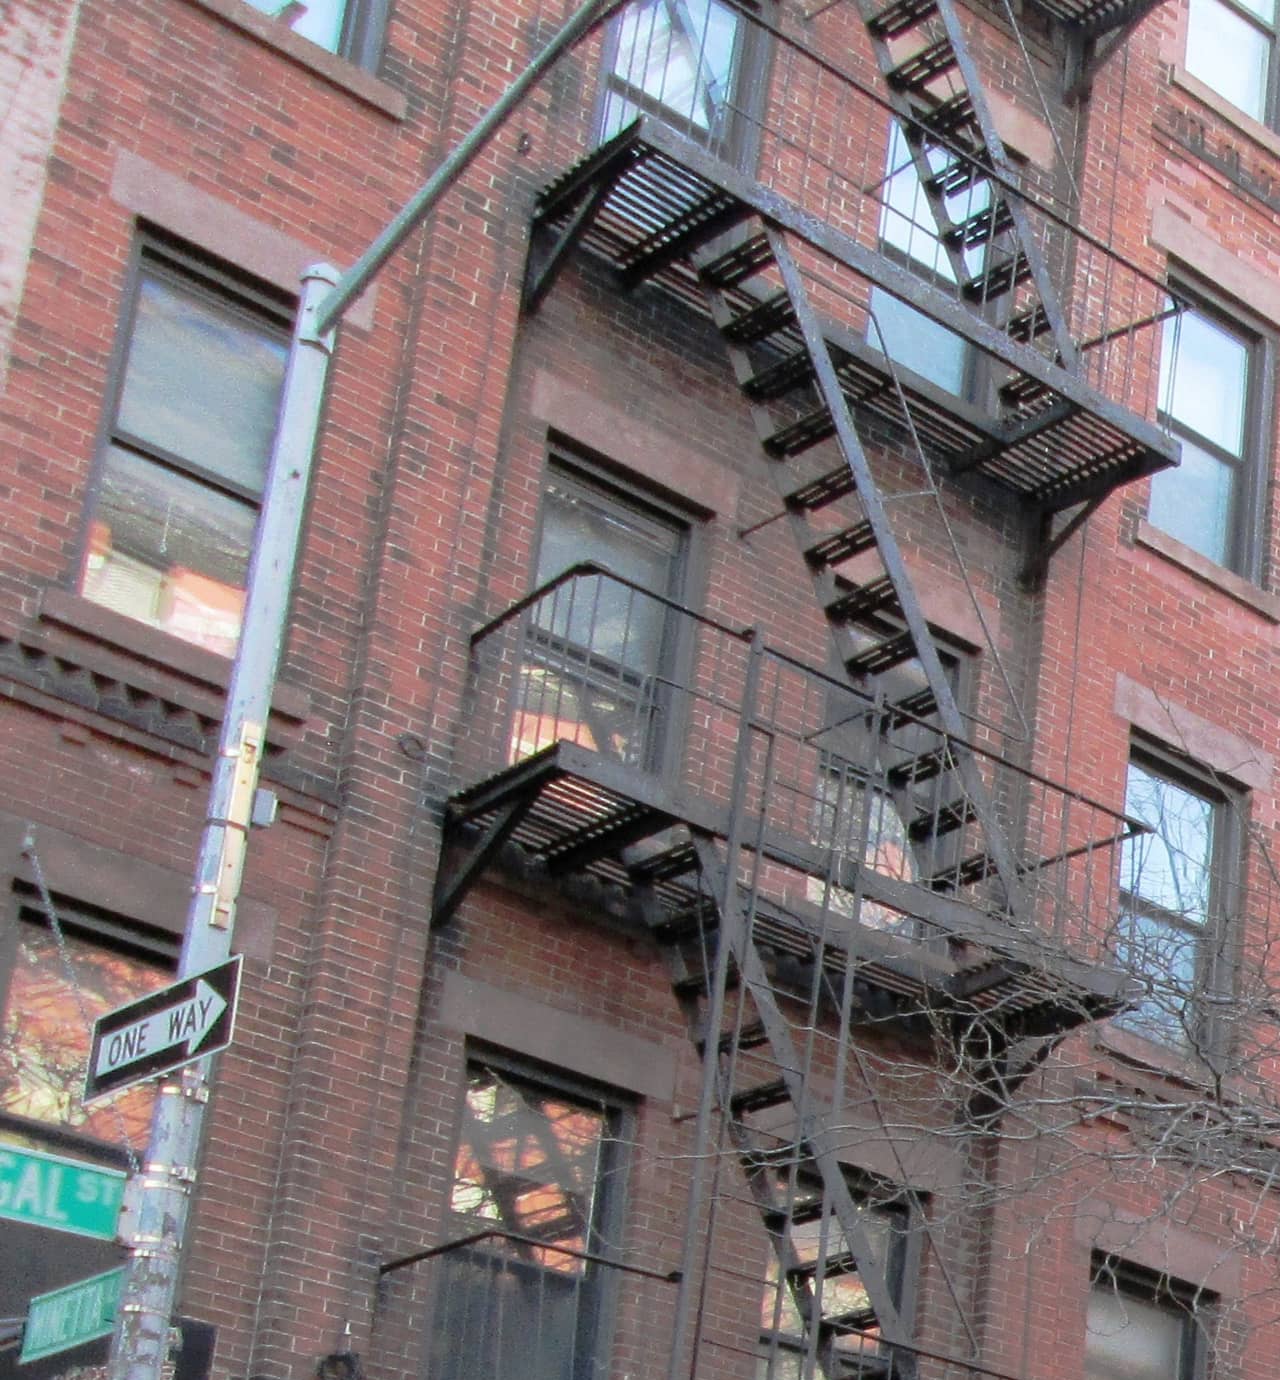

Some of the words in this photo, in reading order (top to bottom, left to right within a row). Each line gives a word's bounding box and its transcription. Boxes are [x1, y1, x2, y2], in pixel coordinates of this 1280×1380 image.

[108, 1023, 149, 1066] ONE
[168, 997, 213, 1042] WAY
[77, 1173, 116, 1205] ST
